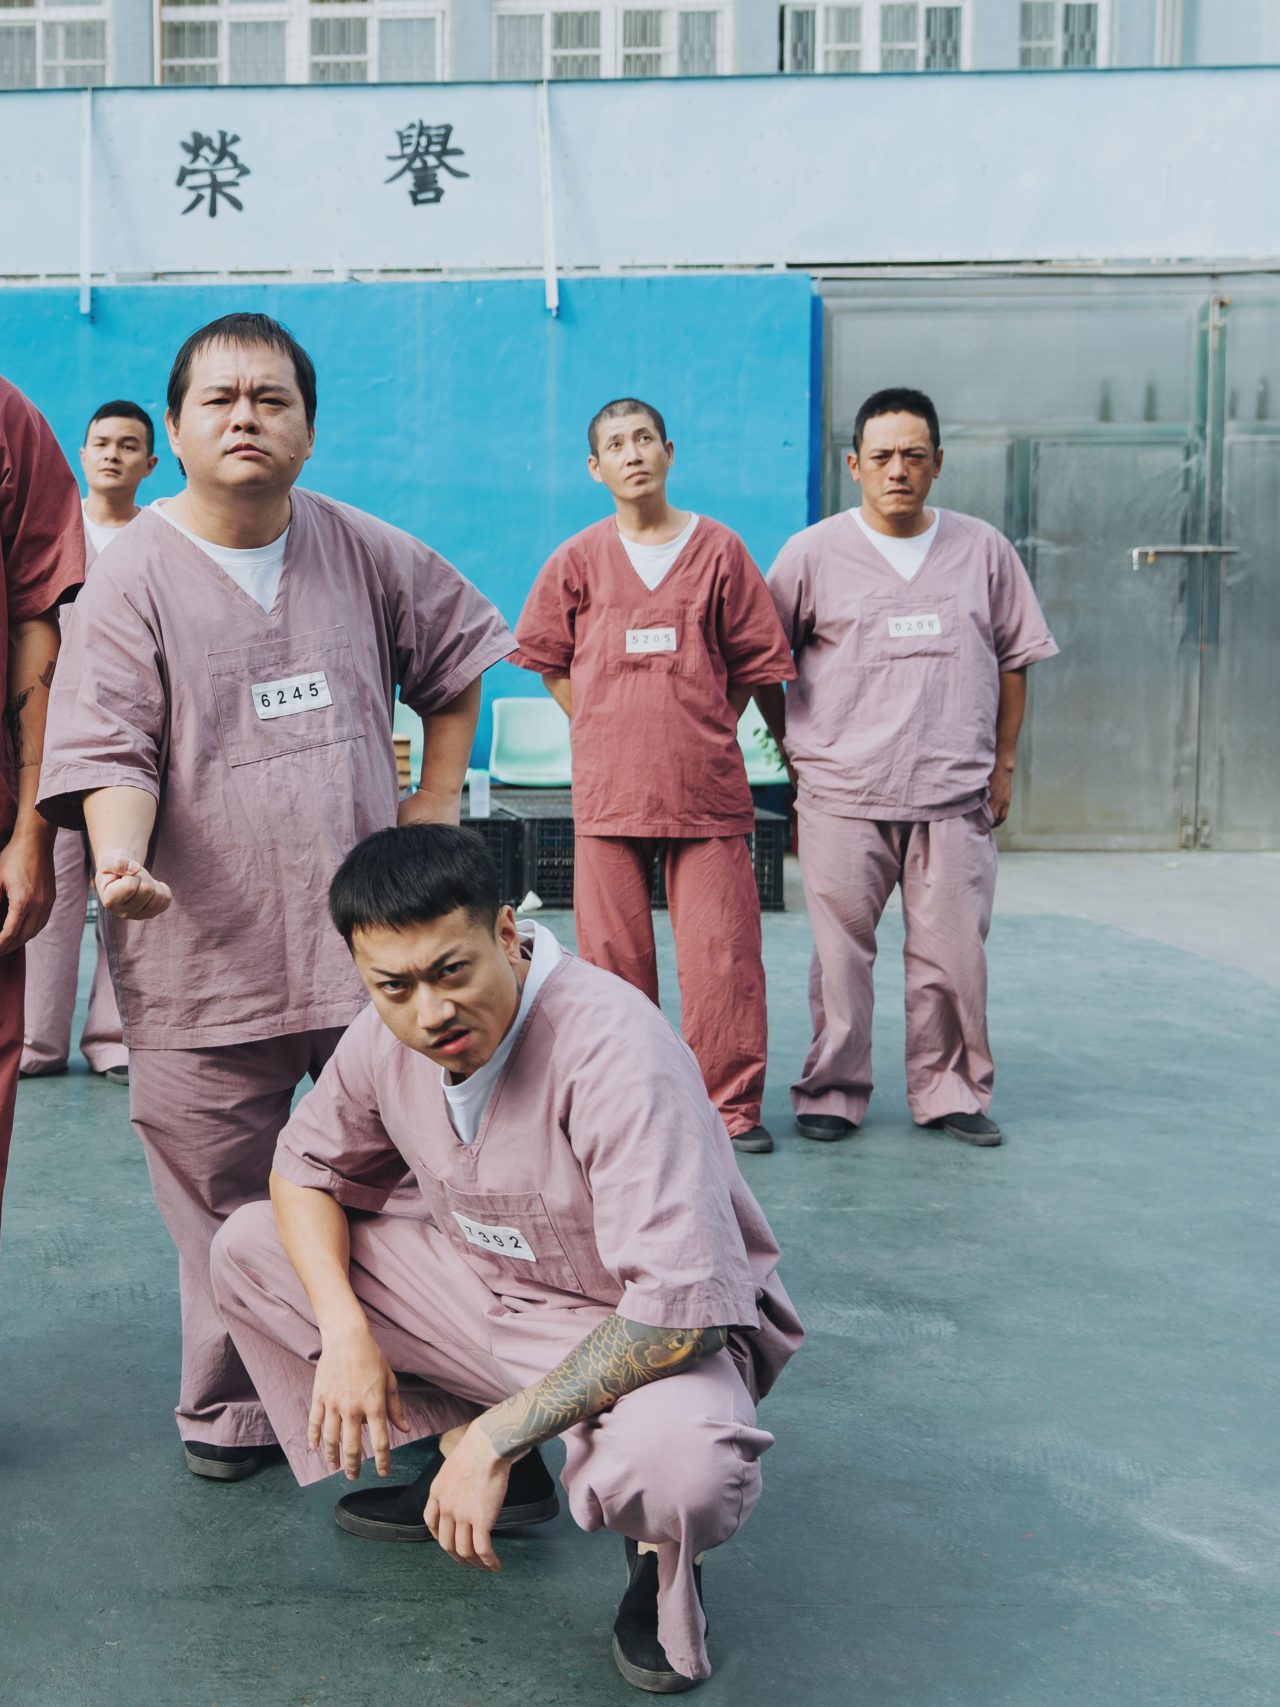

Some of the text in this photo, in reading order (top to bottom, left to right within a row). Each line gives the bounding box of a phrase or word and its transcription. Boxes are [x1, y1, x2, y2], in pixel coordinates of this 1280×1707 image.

[632, 633, 672, 645] 5205
[260, 682, 320, 709] 6245
[464, 1225, 524, 1250] 7392
